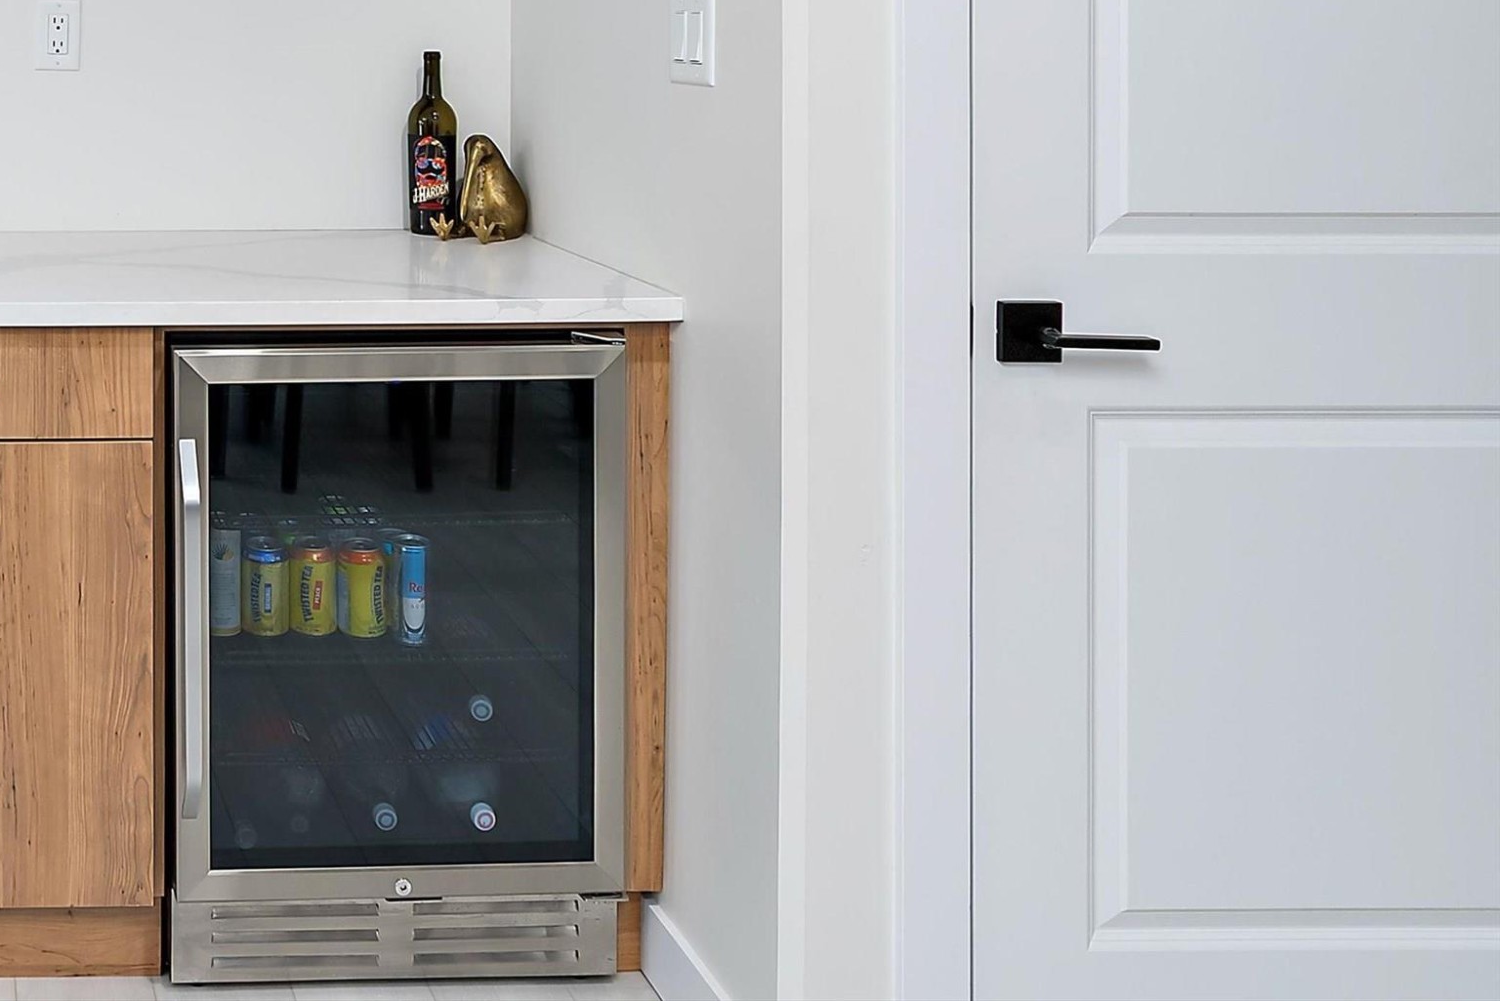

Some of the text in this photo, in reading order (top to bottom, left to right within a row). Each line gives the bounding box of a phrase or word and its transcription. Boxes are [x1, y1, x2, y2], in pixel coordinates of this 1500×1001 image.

[301, 565, 314, 623] TWISTED TEA
[374, 565, 384, 625] TWISTED TEA
